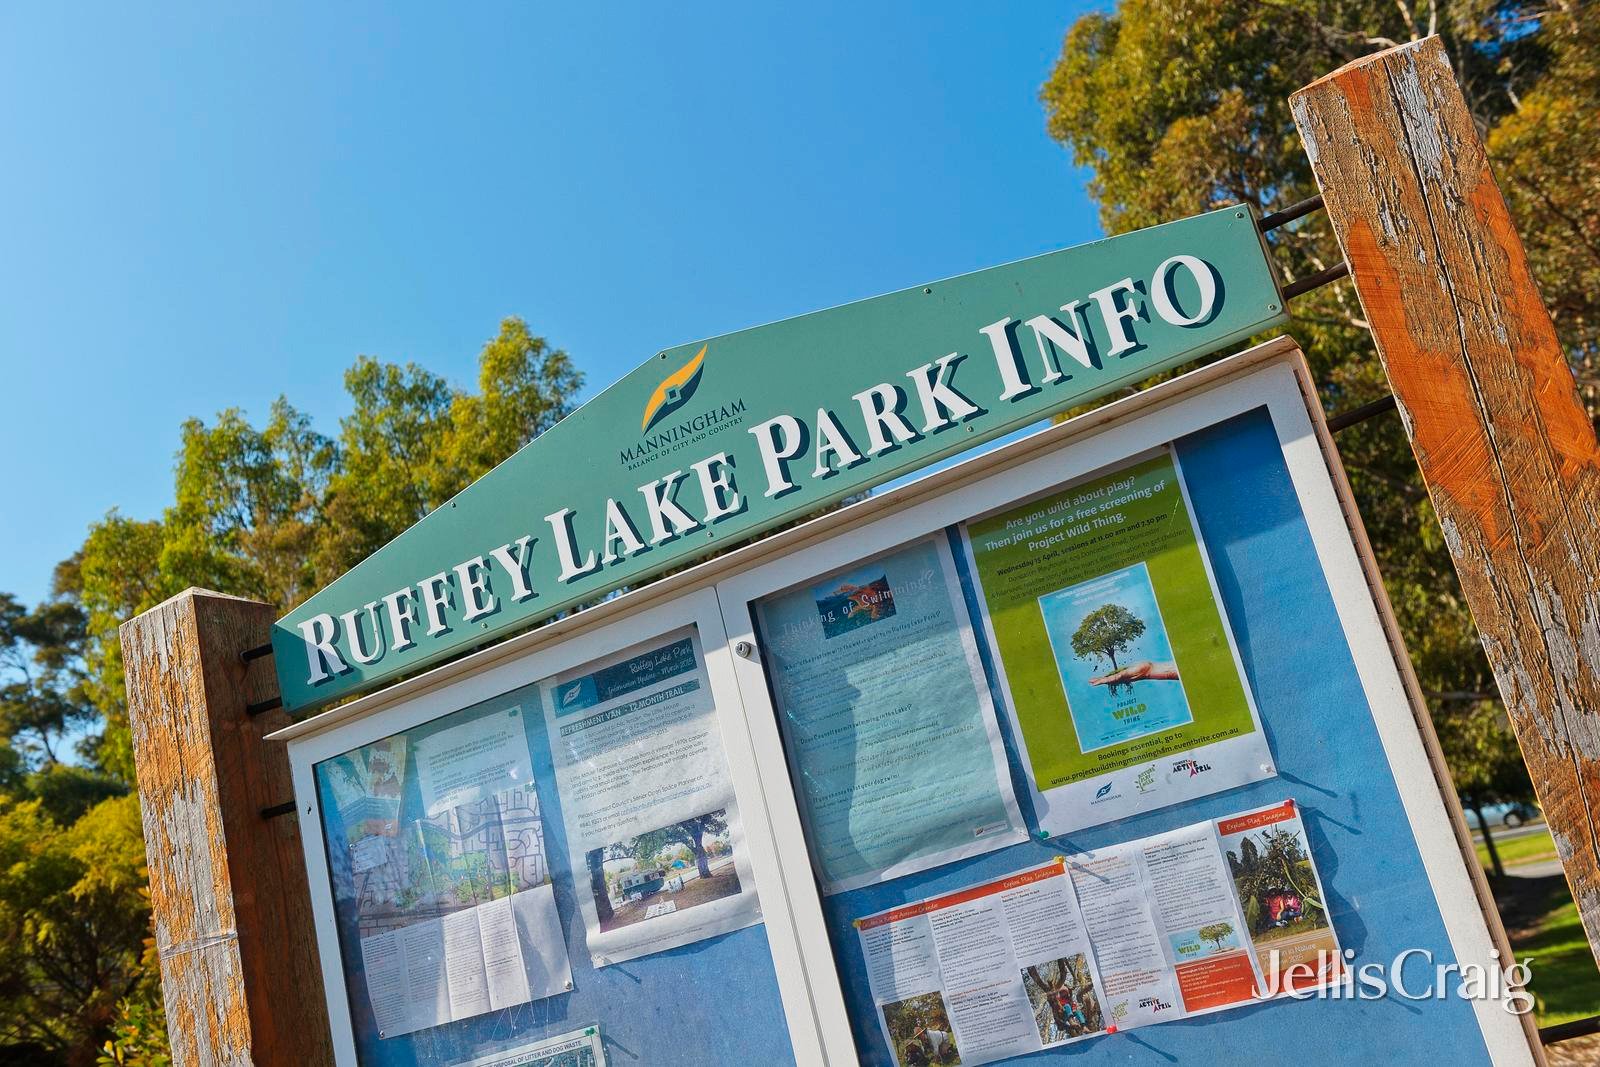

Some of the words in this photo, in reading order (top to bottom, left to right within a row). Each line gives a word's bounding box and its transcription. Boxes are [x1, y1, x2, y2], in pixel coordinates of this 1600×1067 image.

[620, 398, 746, 465] MANNINGHAM
[628, 452, 659, 471] BALANCE
[661, 446, 672, 457] OF
[673, 439, 690, 452] CITY
[691, 432, 707, 444] AND
[709, 416, 743, 436] COUNTRY
[297, 535, 535, 687] RUFFEY
[544, 452, 746, 584] LAKE
[748, 352, 984, 498] PARK
[979, 254, 1222, 402] INFO
[984, 535, 1011, 552] Then
[1010, 527, 1034, 545] join
[1034, 524, 1048, 534] us
[1048, 515, 1065, 529] for
[1066, 514, 1074, 523] a
[1075, 504, 1097, 519] free
[1098, 485, 1153, 513] screening
[1152, 479, 1166, 492] of
[1004, 516, 1023, 530] Are
[1024, 509, 1046, 525] you
[1046, 498, 1071, 515] wild
[1072, 486, 1105, 506] about
[1105, 475, 1137, 496] play?
[996, 557, 1035, 577] Wednesday
[1060, 539, 1089, 554] sessions
[1088, 536, 1096, 544] at
[1114, 527, 1126, 536] am
[1126, 521, 1140, 531] and
[1155, 513, 1168, 522] pm
[1027, 531, 1065, 553] Project
[1065, 521, 1091, 538] Wild
[1091, 509, 1127, 531] Thing.
[1149, 536, 1162, 546] get
[782, 606, 836, 638] Thinking
[840, 599, 856, 615] of
[629, 656, 654, 677] Ruffey
[653, 650, 672, 665] Lake
[671, 642, 692, 659] Park
[560, 713, 604, 735] REFRESHMENT
[605, 707, 621, 720] VAN
[629, 701, 640, 712] 12
[638, 692, 664, 708] MONTH
[1111, 701, 1147, 721] WILD
[1097, 746, 1129, 763] Bookings
[1129, 736, 1163, 753] essential,
[1163, 734, 1174, 743] go
[1173, 730, 1182, 738] to
[1171, 759, 1198, 773] ACTIVE
[1226, 821, 1246, 832] Explore
[1178, 943, 1201, 954] WILD
[1294, 943, 1316, 953] Nature
[1139, 997, 1160, 1009] ACTIVE
